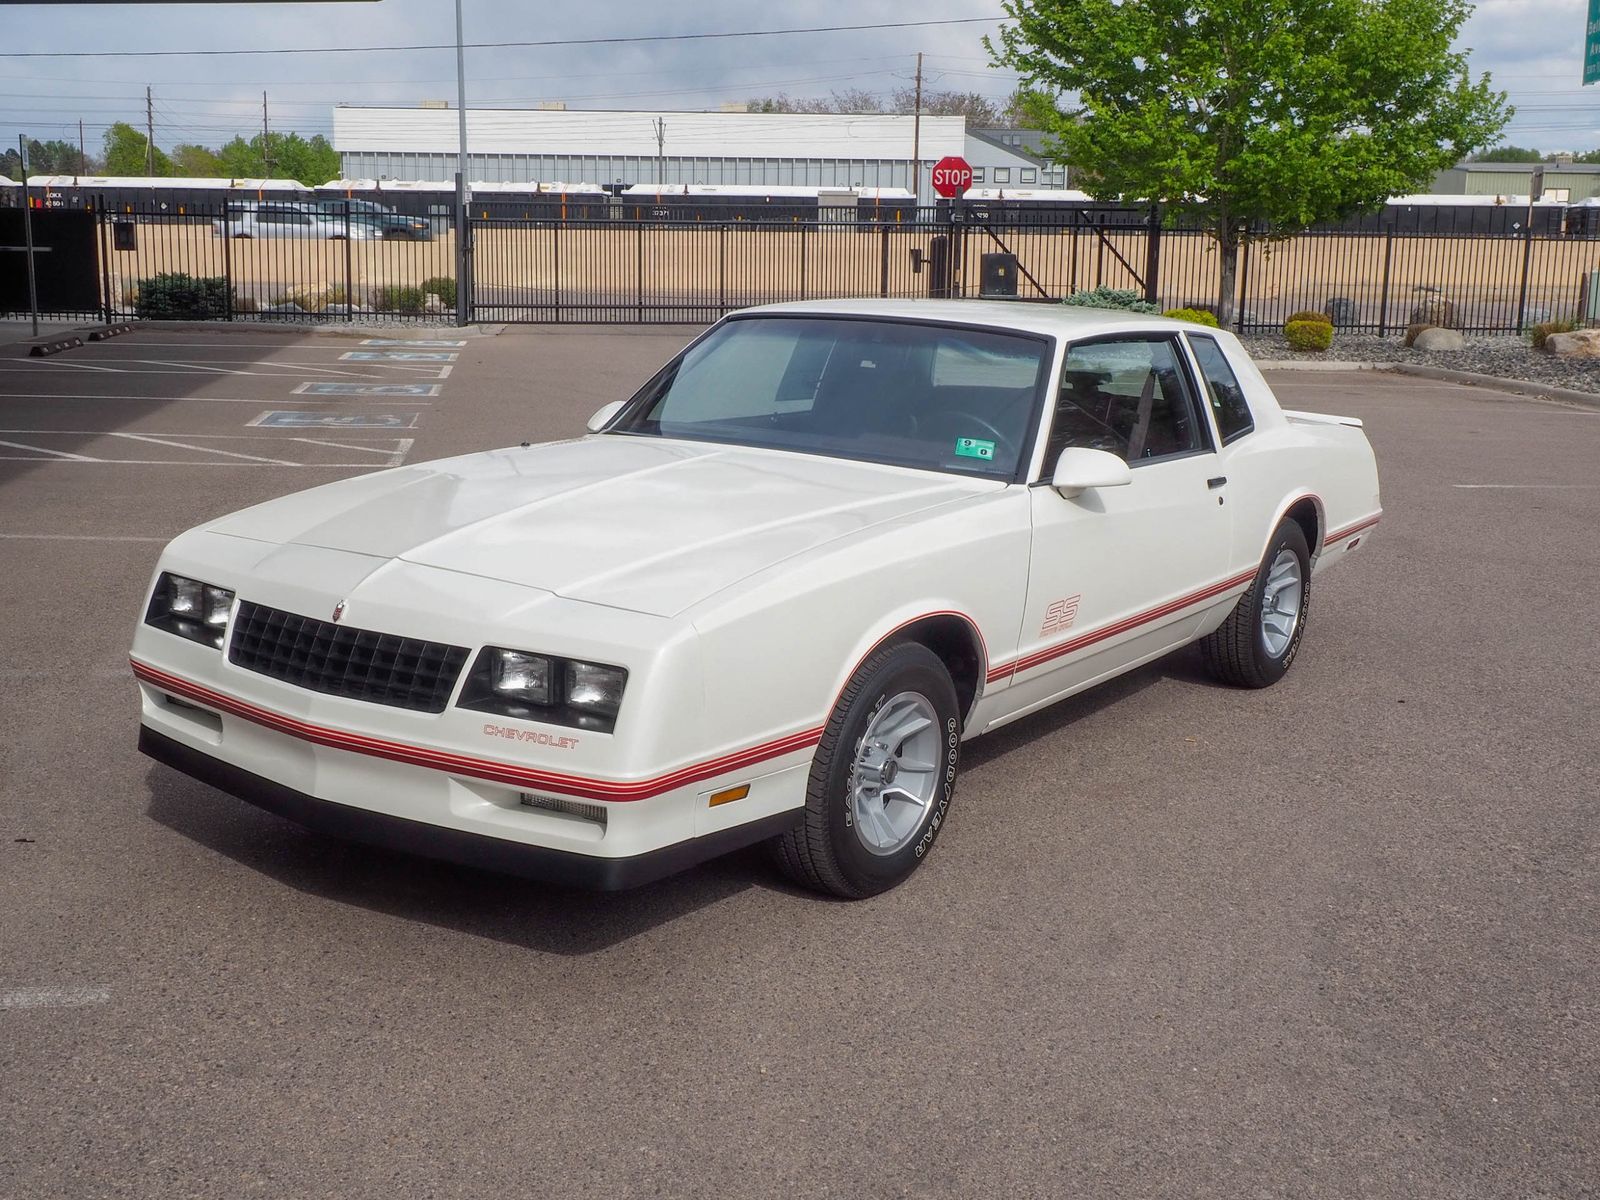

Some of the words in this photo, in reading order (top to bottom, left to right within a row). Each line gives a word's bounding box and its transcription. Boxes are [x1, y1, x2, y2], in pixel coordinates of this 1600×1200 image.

[934, 169, 970, 185] STOP
[1042, 594, 1081, 630] SS
[483, 724, 580, 750] CHEVROLET
[914, 717, 958, 858] GOODYEAR
